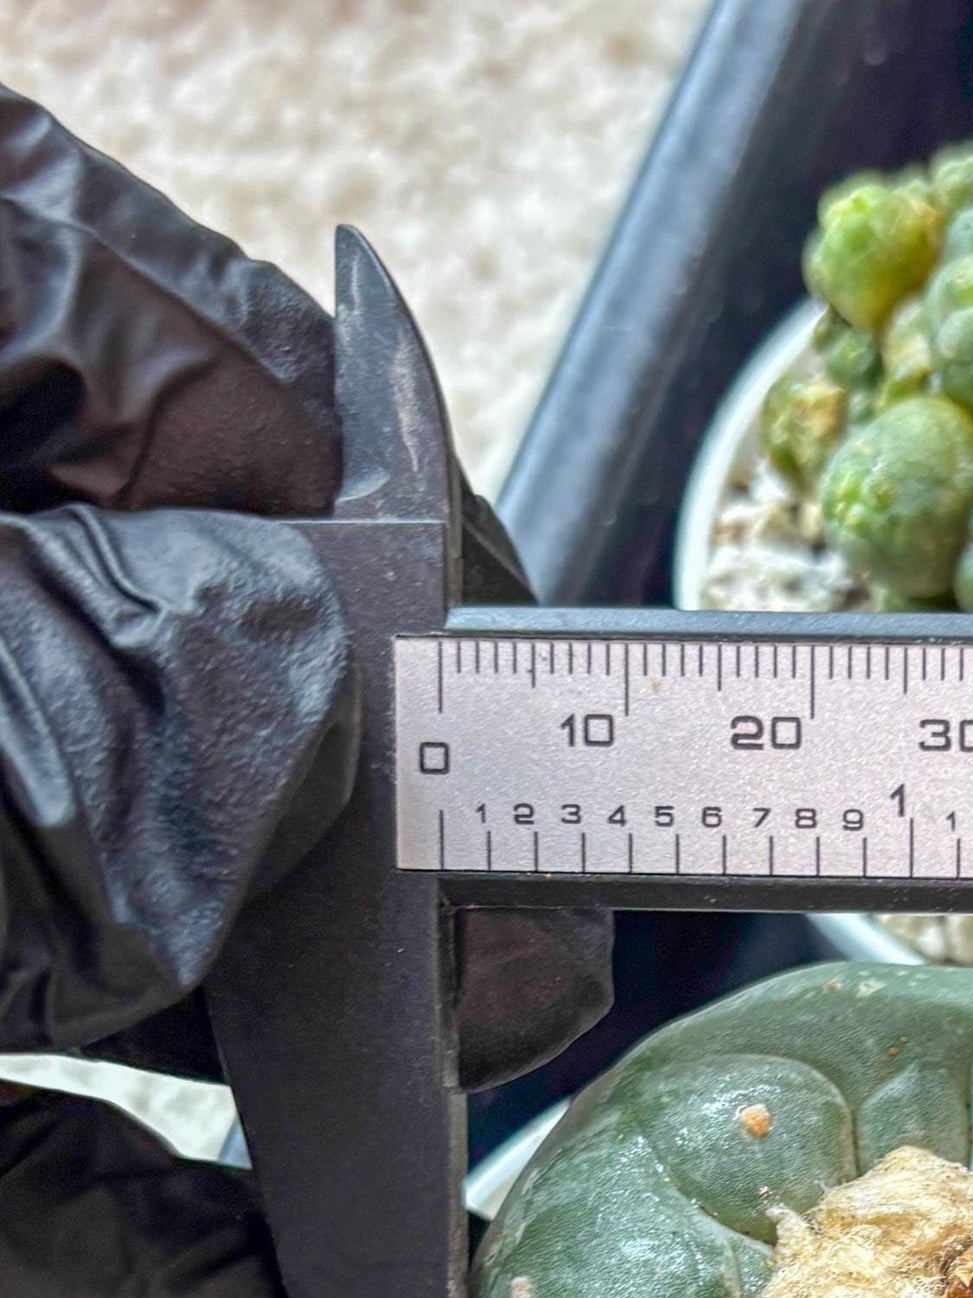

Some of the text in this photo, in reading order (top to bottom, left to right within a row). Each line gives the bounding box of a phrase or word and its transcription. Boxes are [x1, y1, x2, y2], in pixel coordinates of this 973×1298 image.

[560, 714, 614, 747] 10
[730, 715, 801, 750] 20
[419, 742, 449, 775] 0
[889, 784, 905, 817] 1
[475, 803, 486, 823] 1
[513, 803, 535, 825] 2
[561, 804, 582, 824] 3
[607, 806, 628, 827] 4
[655, 806, 674, 827] 5
[701, 807, 722, 828] 6
[751, 808, 772, 828] 7
[795, 808, 817, 829] 8
[843, 809, 864, 832] 9
[945, 812, 956, 832] 1
